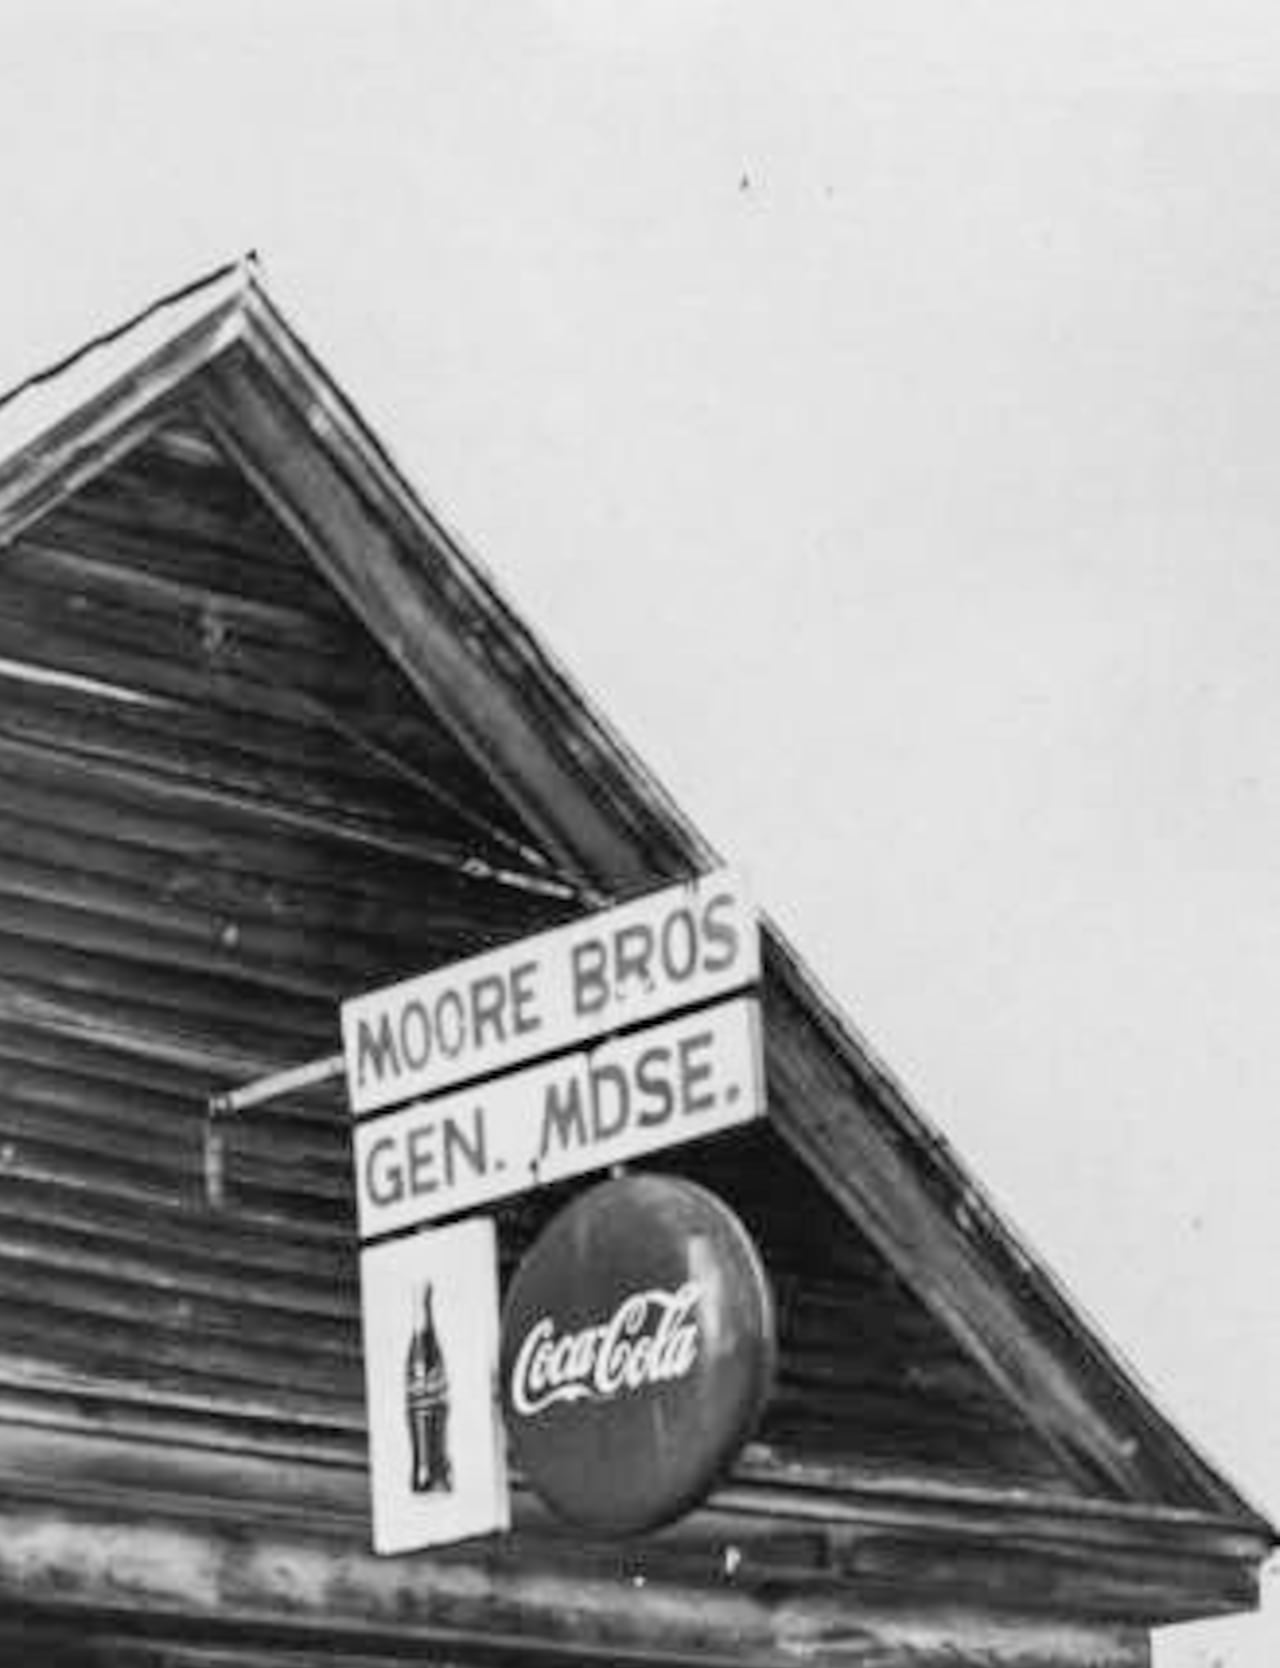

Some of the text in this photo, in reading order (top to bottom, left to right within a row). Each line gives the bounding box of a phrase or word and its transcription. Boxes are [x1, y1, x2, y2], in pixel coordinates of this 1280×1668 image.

[357, 960, 541, 1086] MOORE
[365, 1031, 740, 1208] GEN. MDSE.
